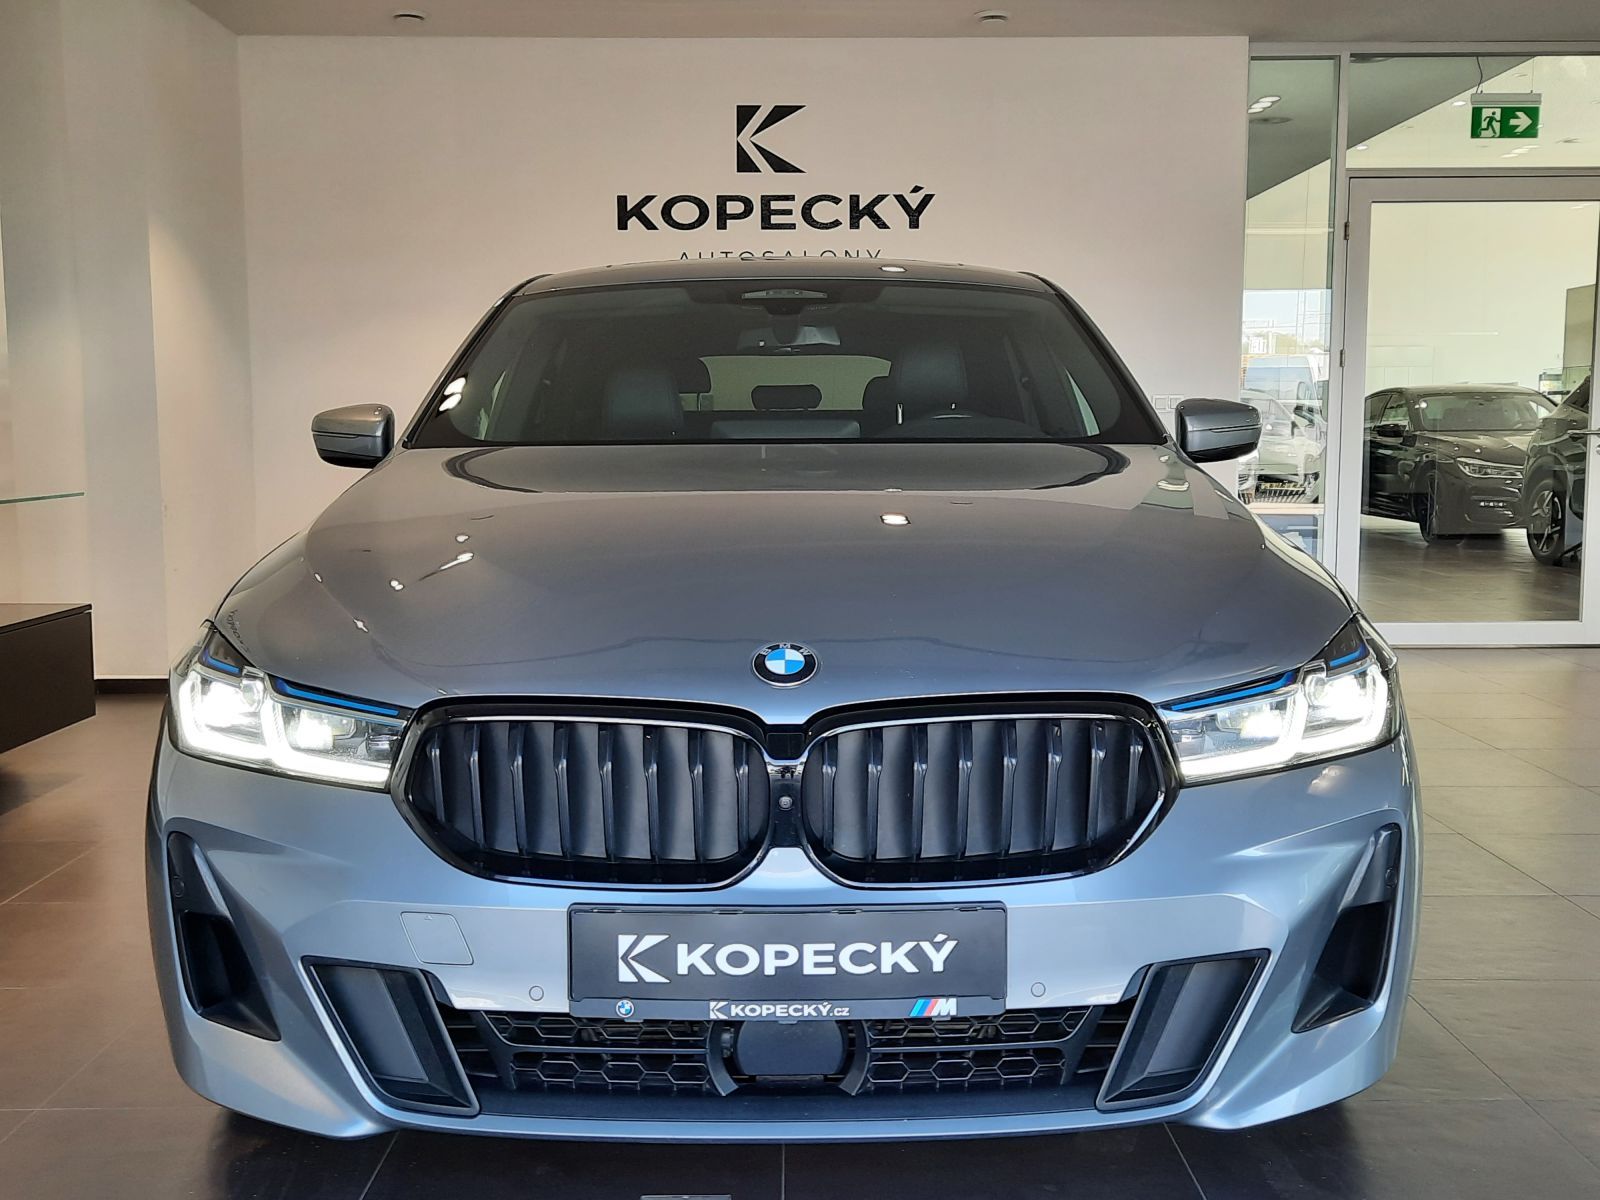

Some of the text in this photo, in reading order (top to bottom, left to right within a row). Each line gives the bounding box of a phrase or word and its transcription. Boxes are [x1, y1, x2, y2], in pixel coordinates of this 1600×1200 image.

[616, 185, 936, 231] KOPECKÝ
[676, 933, 960, 976] KOPECKÝ
[730, 1001, 850, 1017] KOPECKÝ.cz
